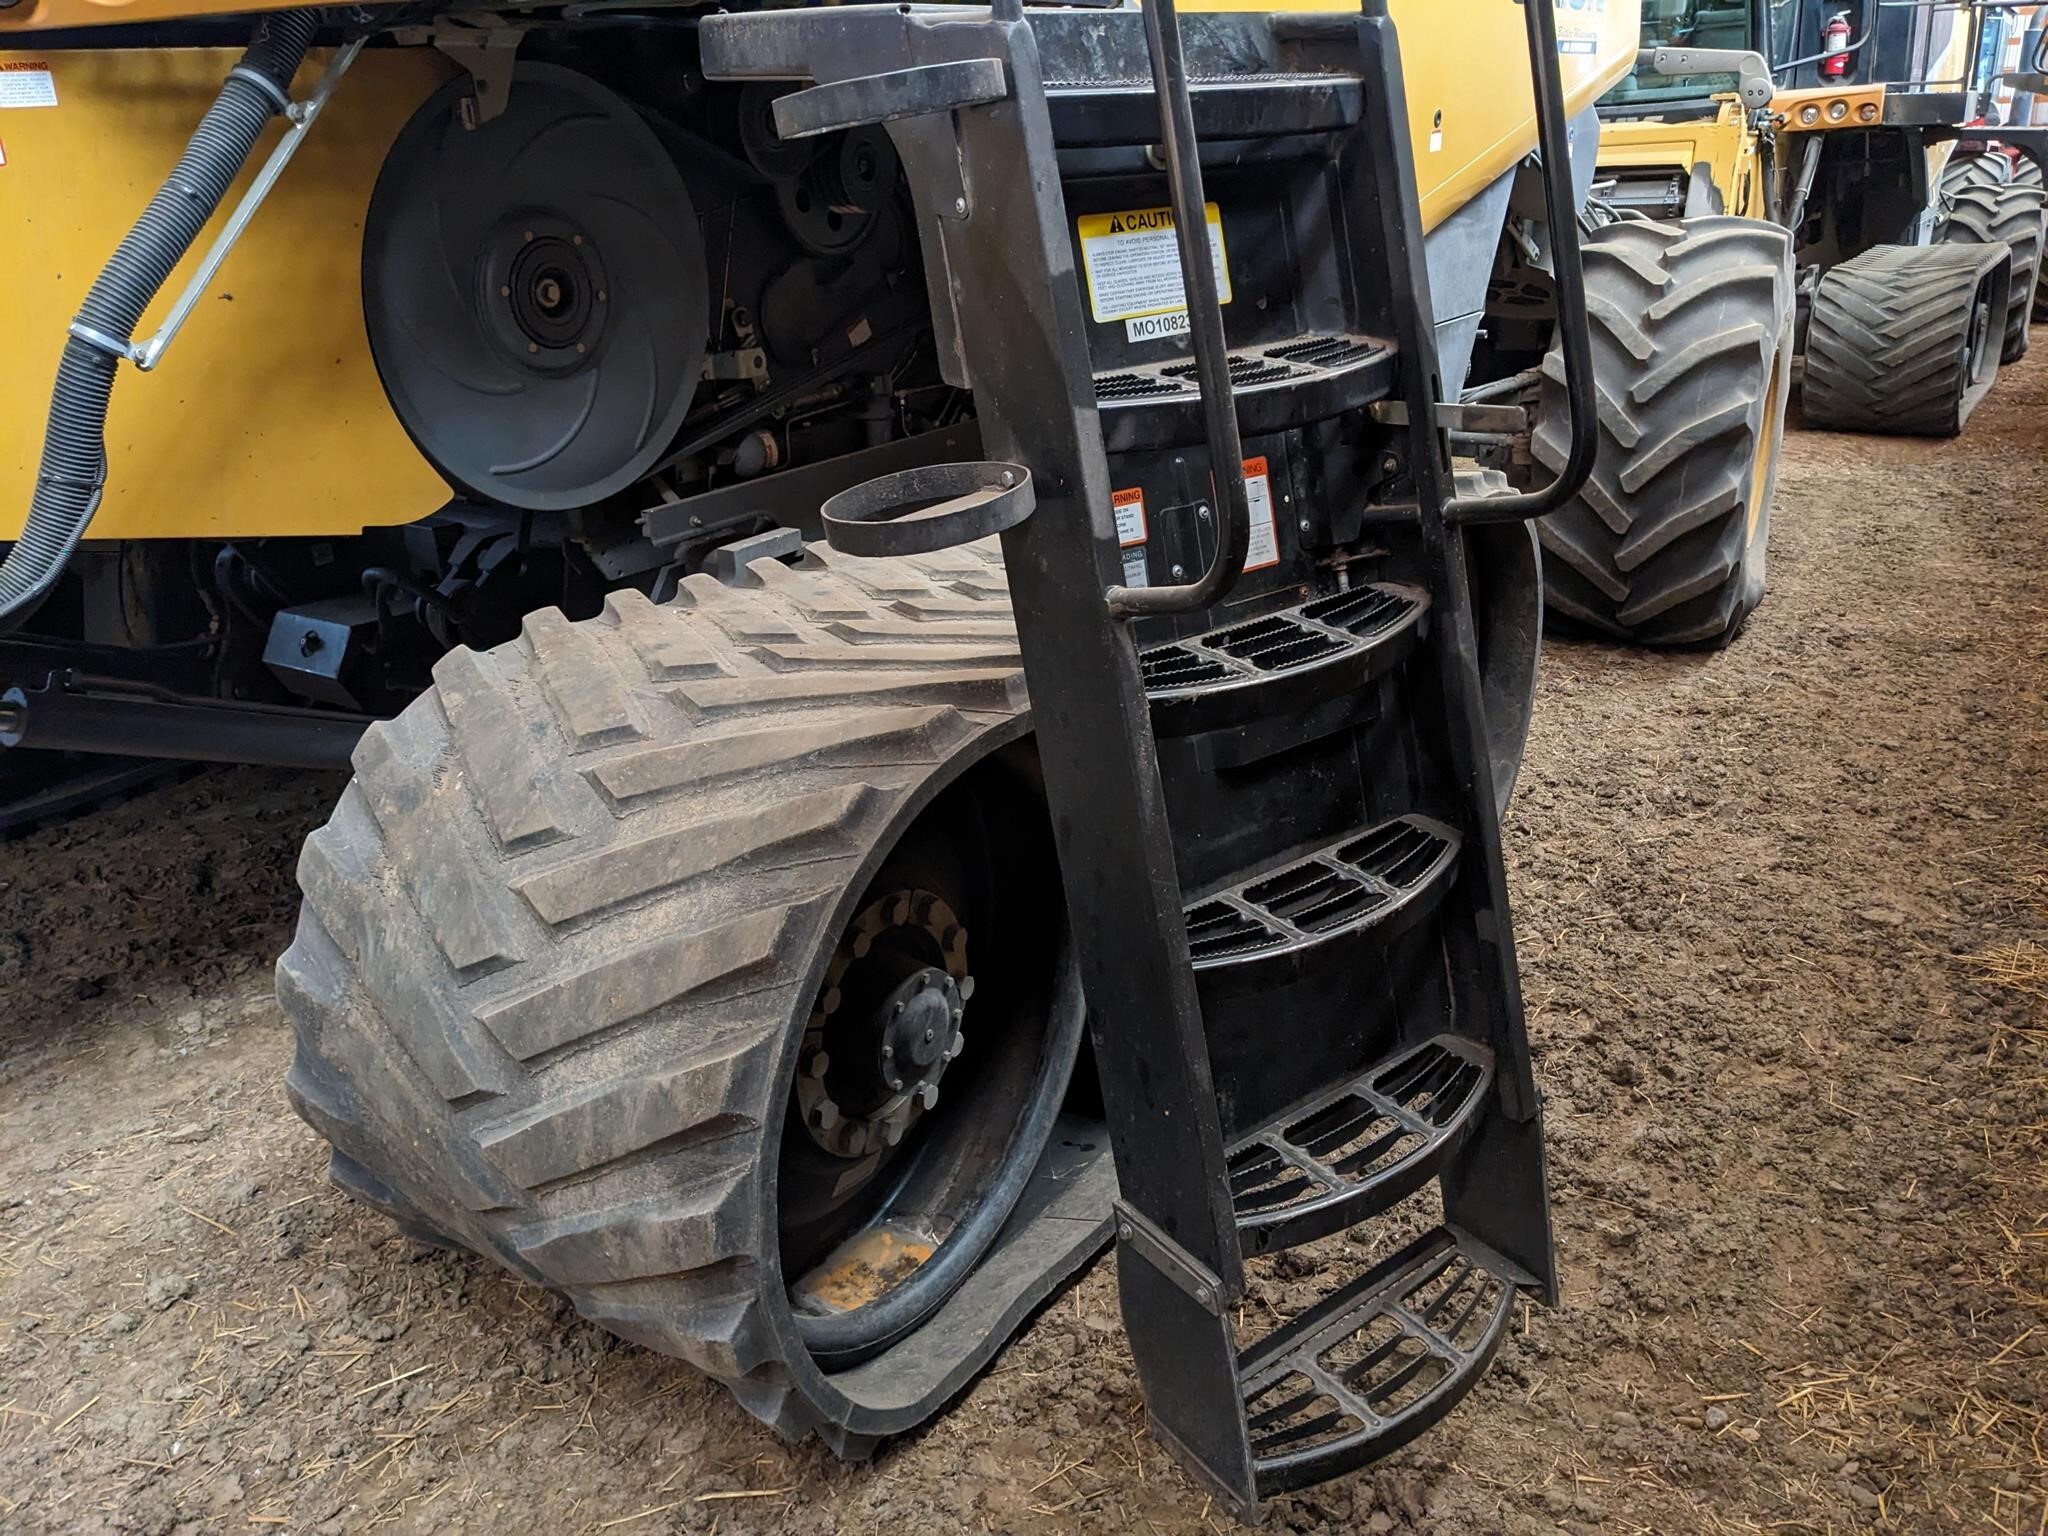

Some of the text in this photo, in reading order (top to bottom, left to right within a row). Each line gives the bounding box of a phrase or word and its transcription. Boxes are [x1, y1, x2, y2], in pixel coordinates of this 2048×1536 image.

[4, 61, 49, 71] WARNING
[1126, 211, 1176, 230] CAUTI
[1124, 236, 1141, 245] AVOID
[1141, 233, 1169, 243] PERSONAL
[1114, 490, 1141, 504] RNING
[1122, 550, 1143, 561] ADING
